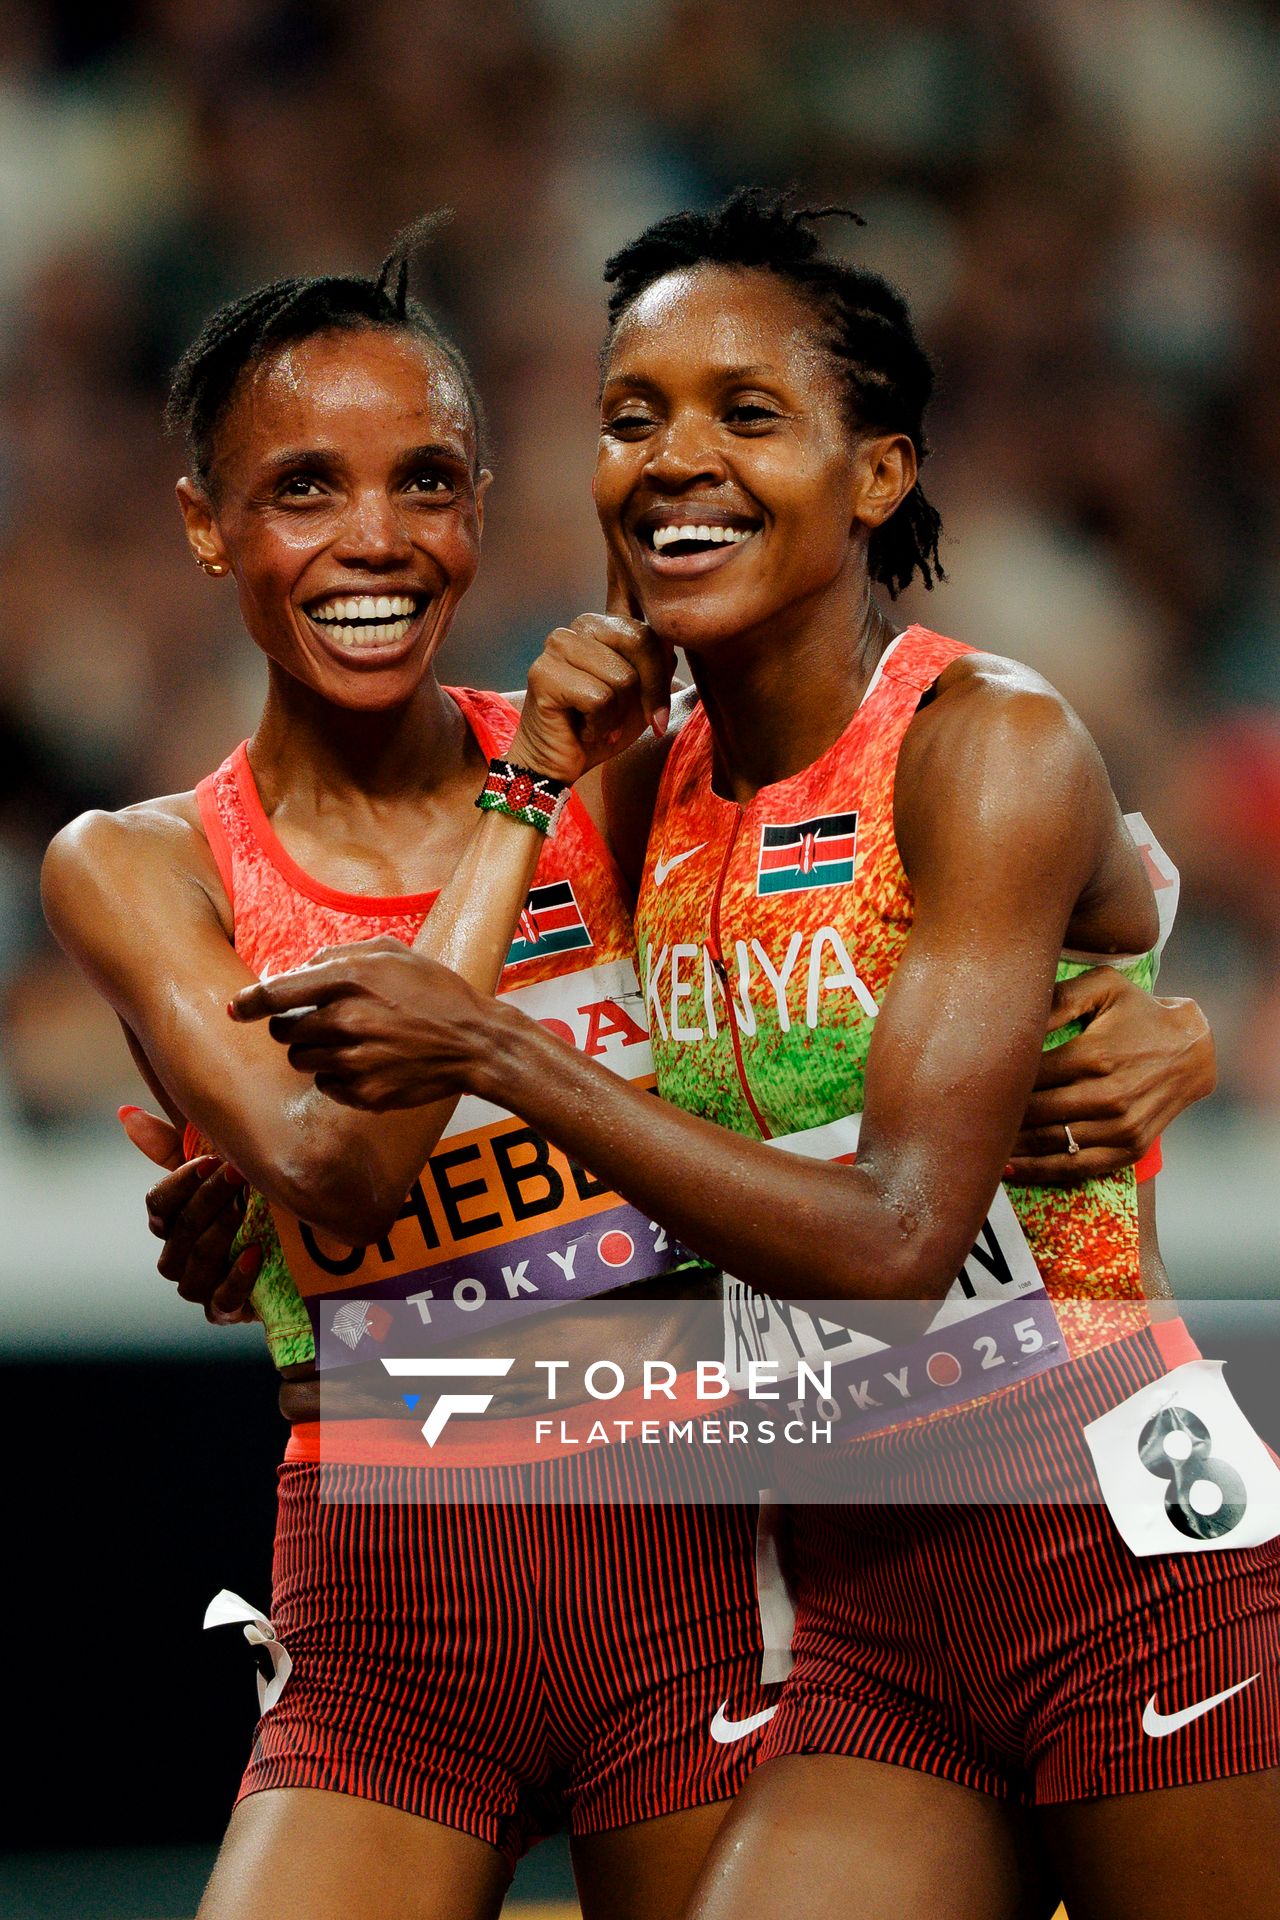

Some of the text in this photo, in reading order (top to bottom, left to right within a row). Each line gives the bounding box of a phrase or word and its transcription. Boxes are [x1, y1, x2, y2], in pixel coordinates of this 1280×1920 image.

[646, 926, 879, 1041] KENYA
[536, 998, 651, 1057] A
[973, 1318, 1044, 1370] 25
[1137, 1406, 1248, 1540] 8
